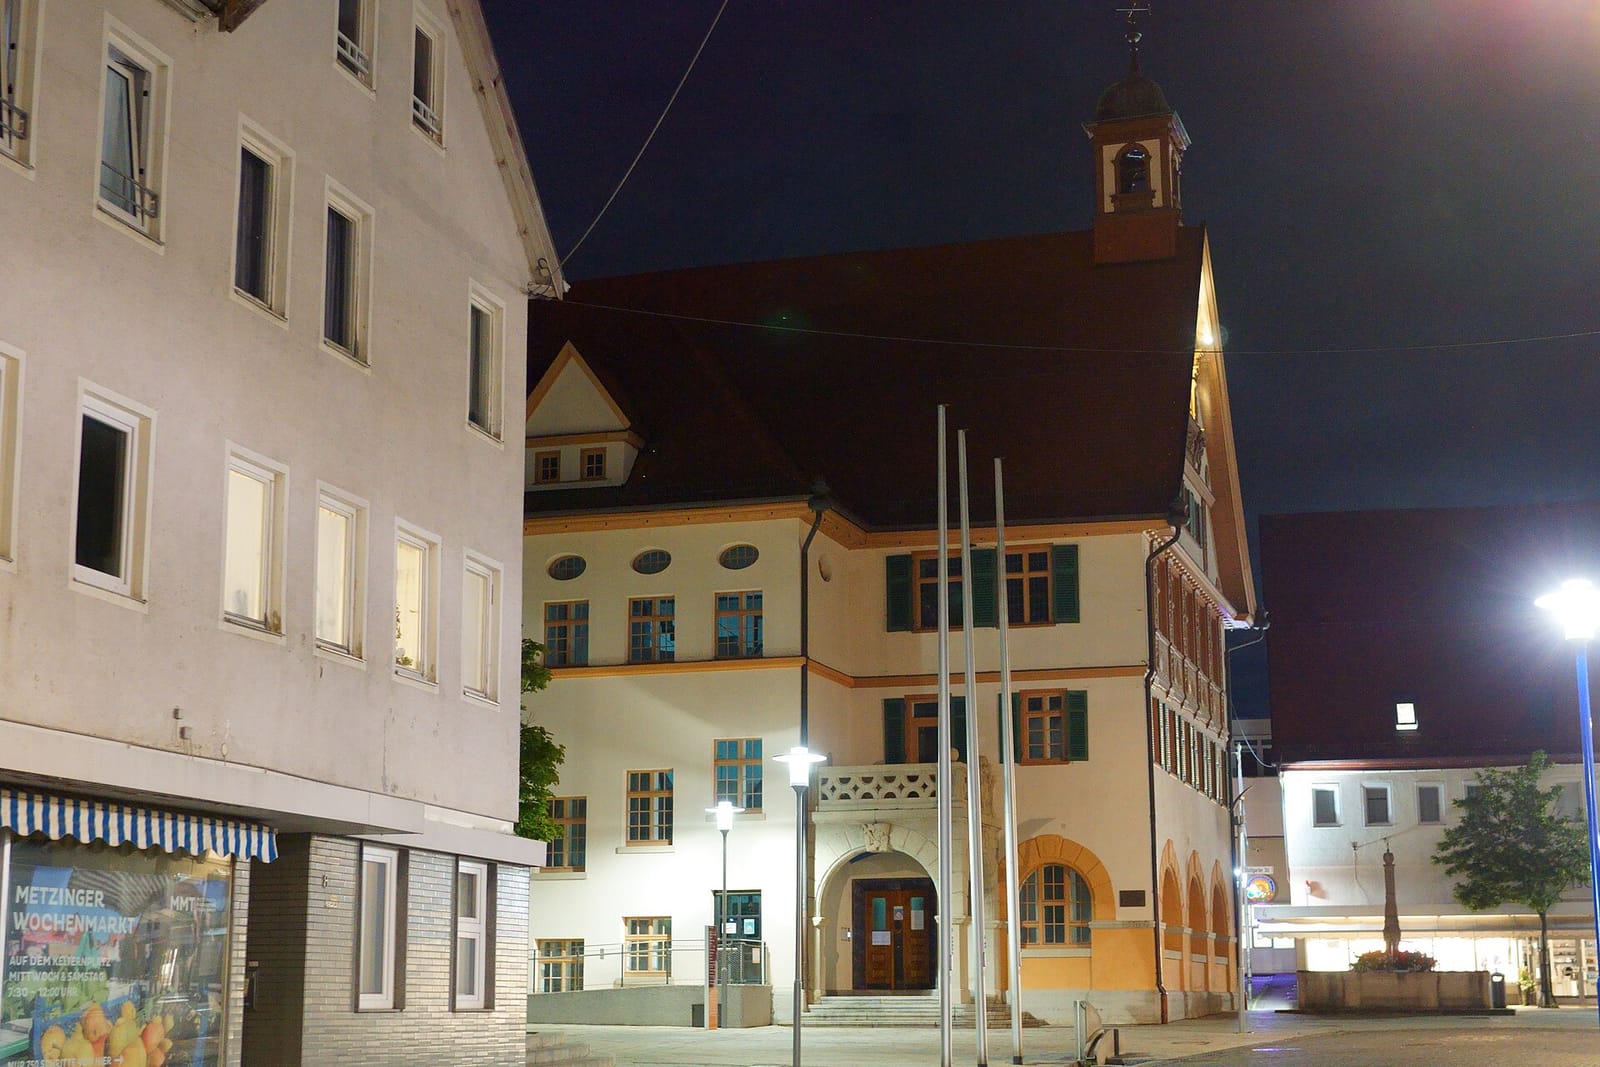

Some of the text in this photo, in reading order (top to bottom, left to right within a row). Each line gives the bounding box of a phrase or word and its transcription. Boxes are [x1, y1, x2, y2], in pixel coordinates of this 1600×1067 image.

[15, 885, 105, 908] METZINGER
[13, 911, 136, 935] WOCHENMARKT
[9, 955, 28, 966] AUF
[30, 956, 51, 967] DEM
[8, 971, 59, 982] MITTWOCH
[67, 972, 105, 982] SAMSTAG
